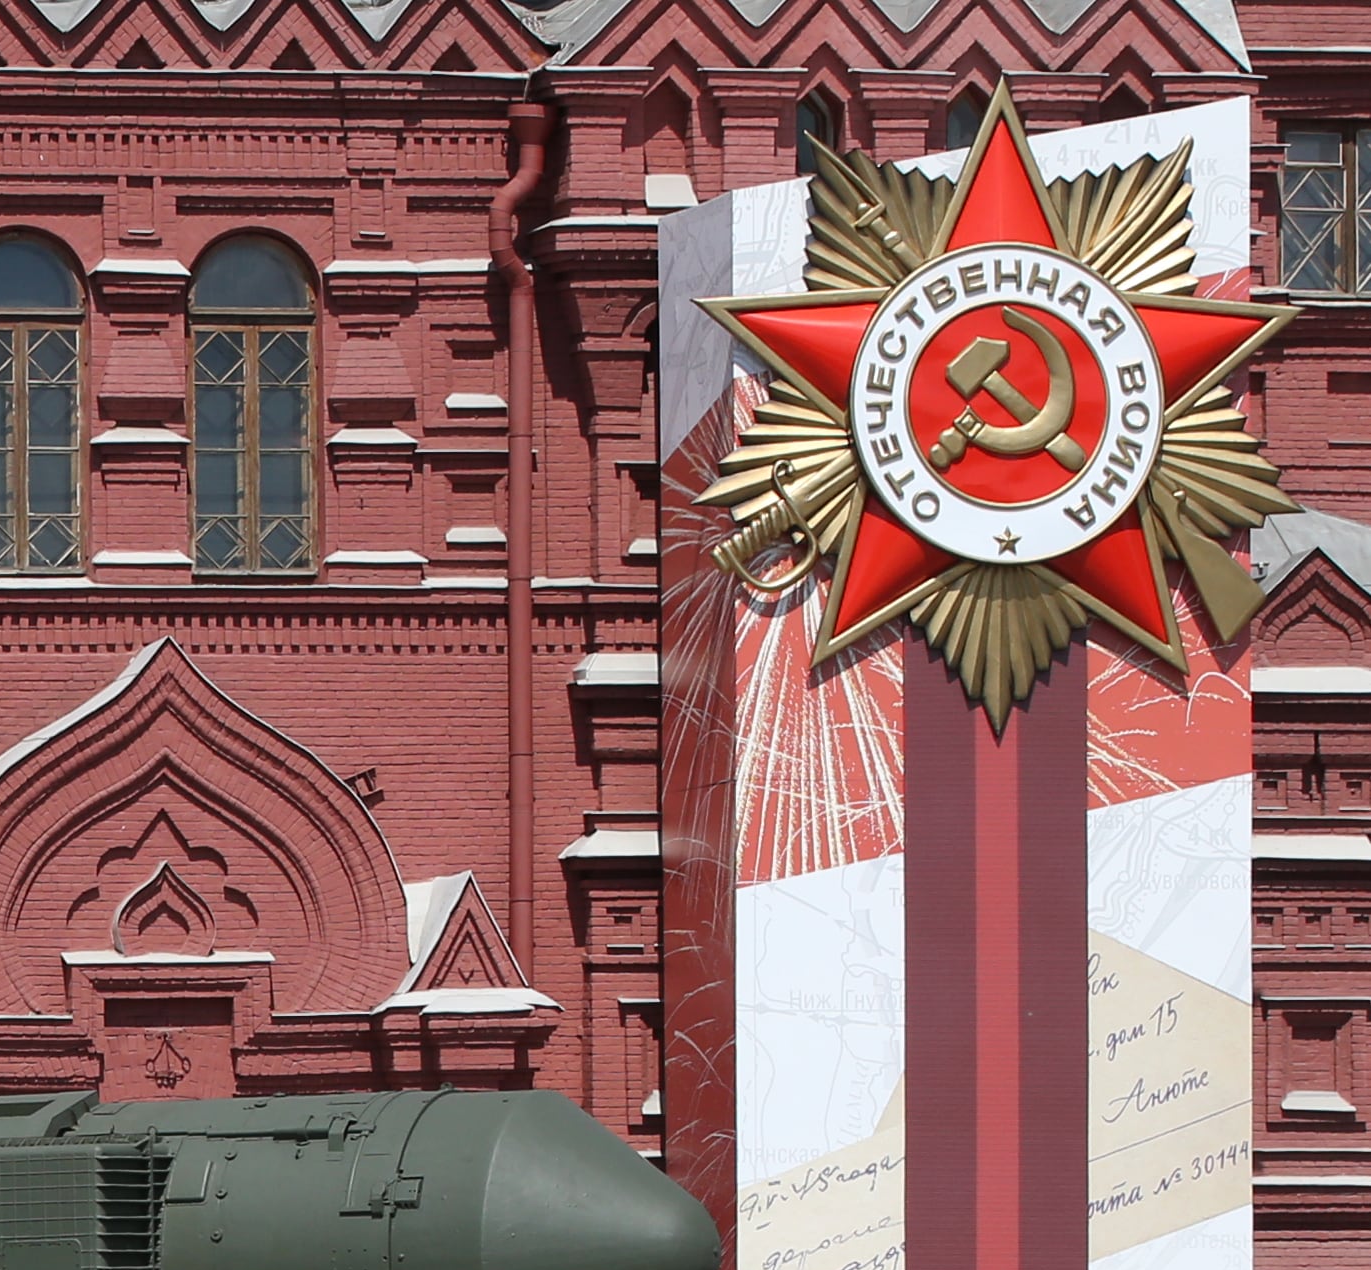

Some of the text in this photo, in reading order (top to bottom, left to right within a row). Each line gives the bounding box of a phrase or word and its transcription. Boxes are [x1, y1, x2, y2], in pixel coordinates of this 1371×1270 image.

[861, 257, 1129, 522] ОТЕЧЕСТВЕННАЯ
[1148, 991, 1184, 1037] 15
[1190, 1139, 1250, 1181] 30144
